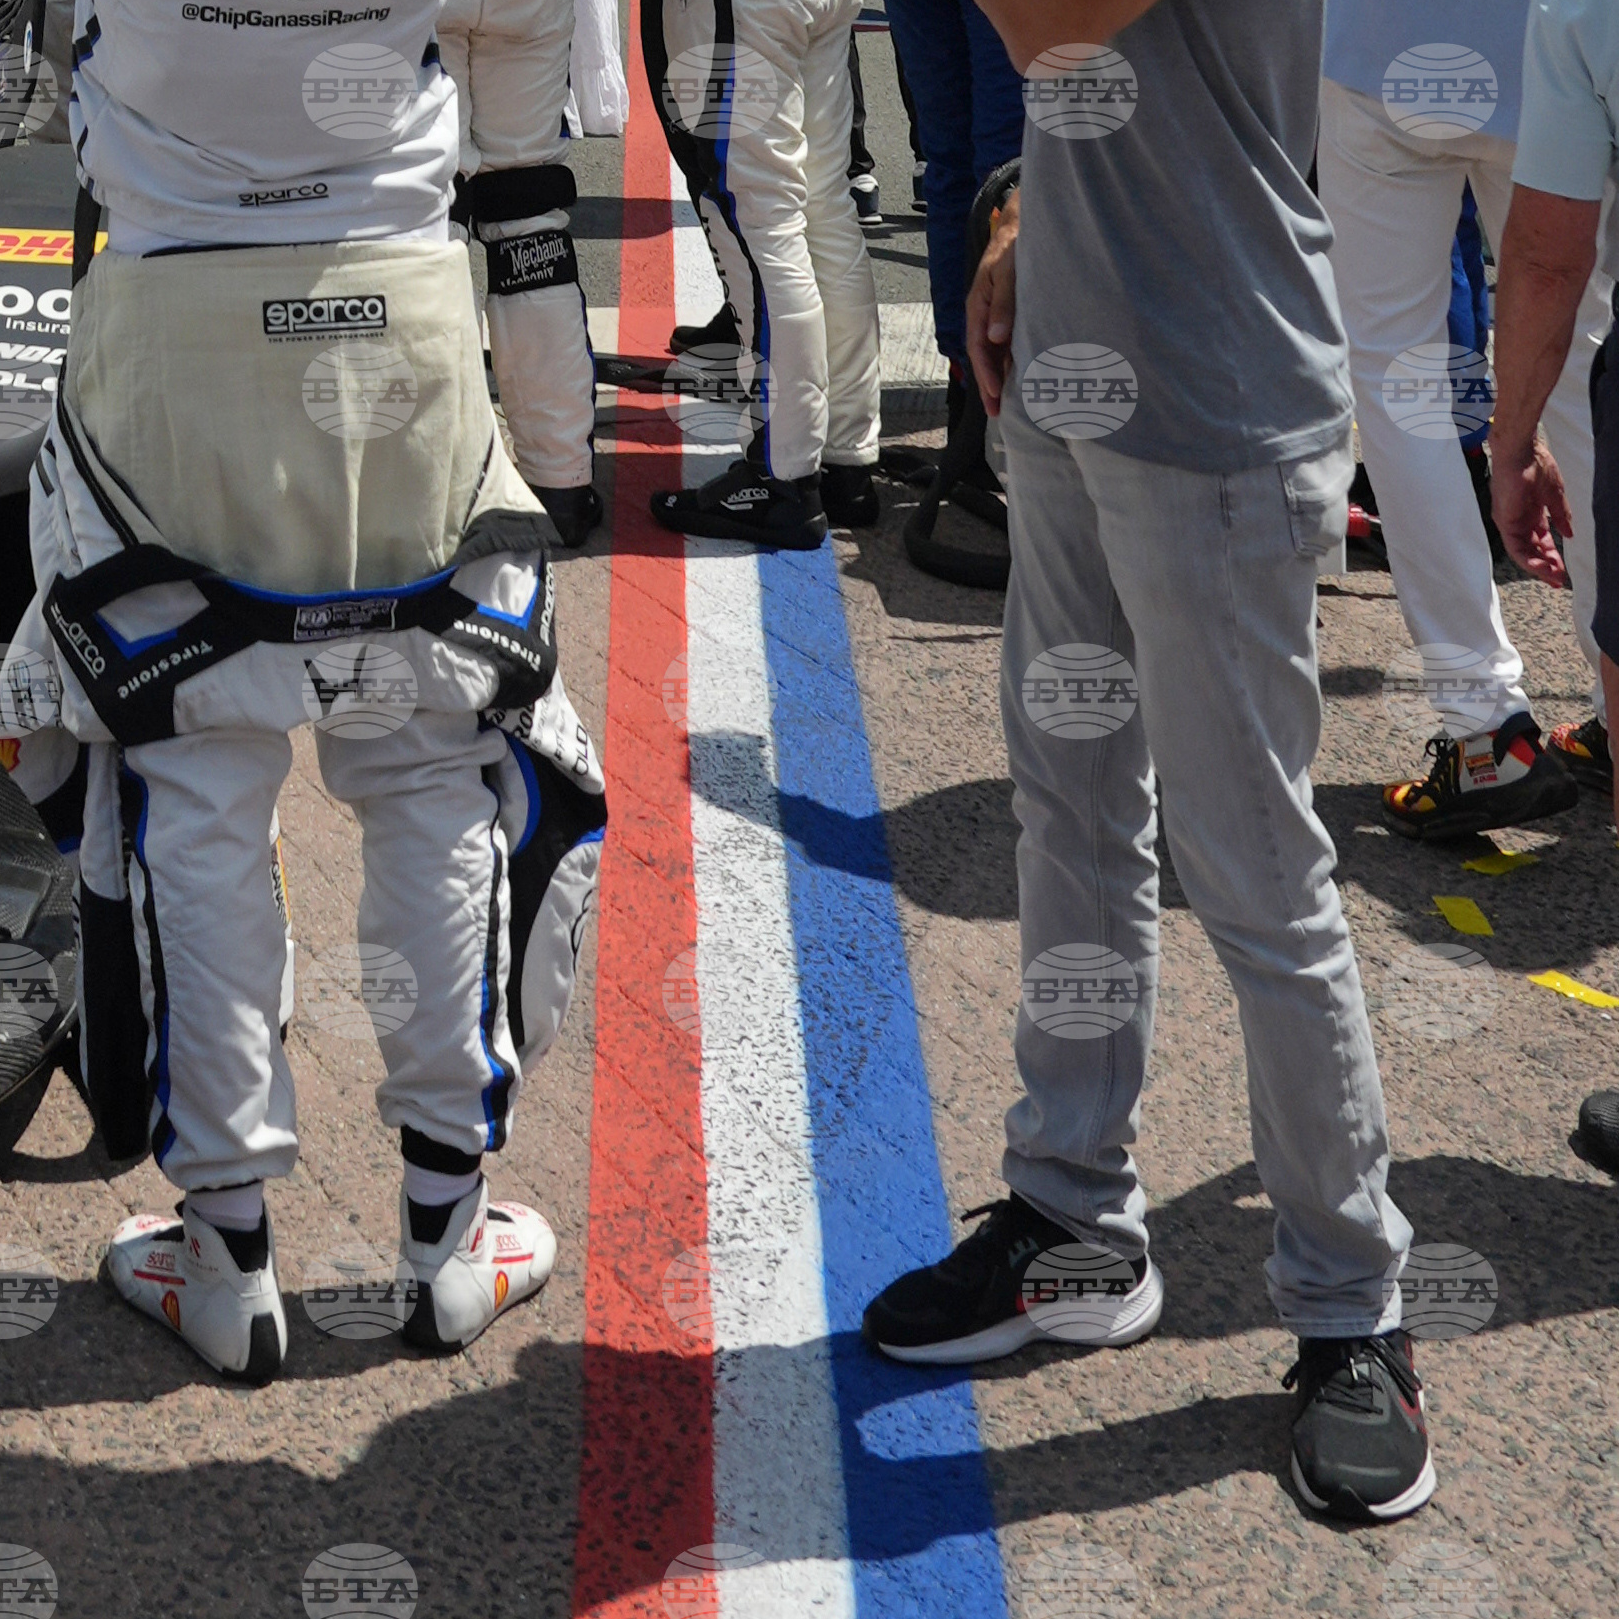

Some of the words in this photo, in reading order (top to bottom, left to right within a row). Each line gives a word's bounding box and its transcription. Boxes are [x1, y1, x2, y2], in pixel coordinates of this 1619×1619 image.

[181, 3, 391, 30] @ChipGanassiRacing
[265, 296, 385, 331] sparco
[453, 618, 542, 672] Firestone
[116, 639, 214, 700] Firestone
